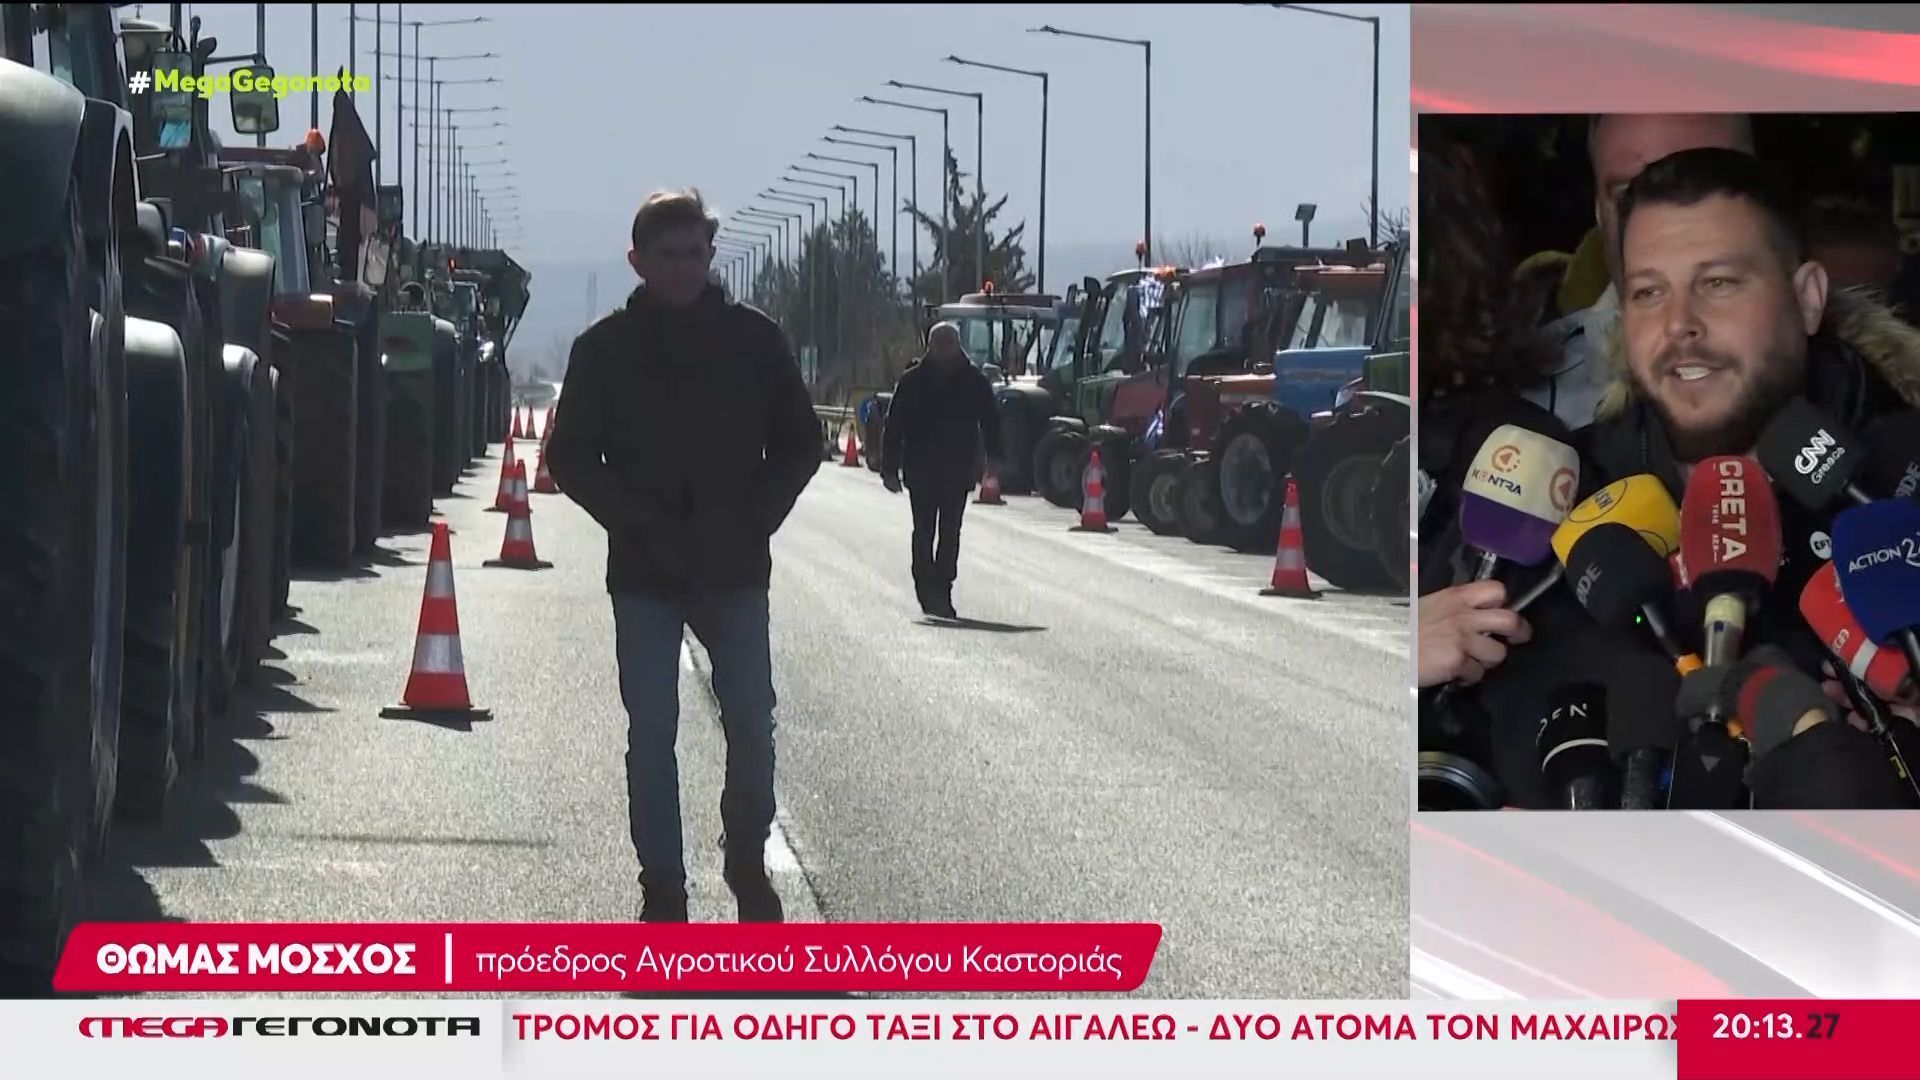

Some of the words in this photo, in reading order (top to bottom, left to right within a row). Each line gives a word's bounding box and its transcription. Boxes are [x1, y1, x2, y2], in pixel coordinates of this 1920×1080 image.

[1795, 429, 1836, 474] CNN
[1811, 447, 1846, 484] Greece
[1719, 460, 1747, 562] CRETA
[1848, 544, 1902, 573] ACTION
